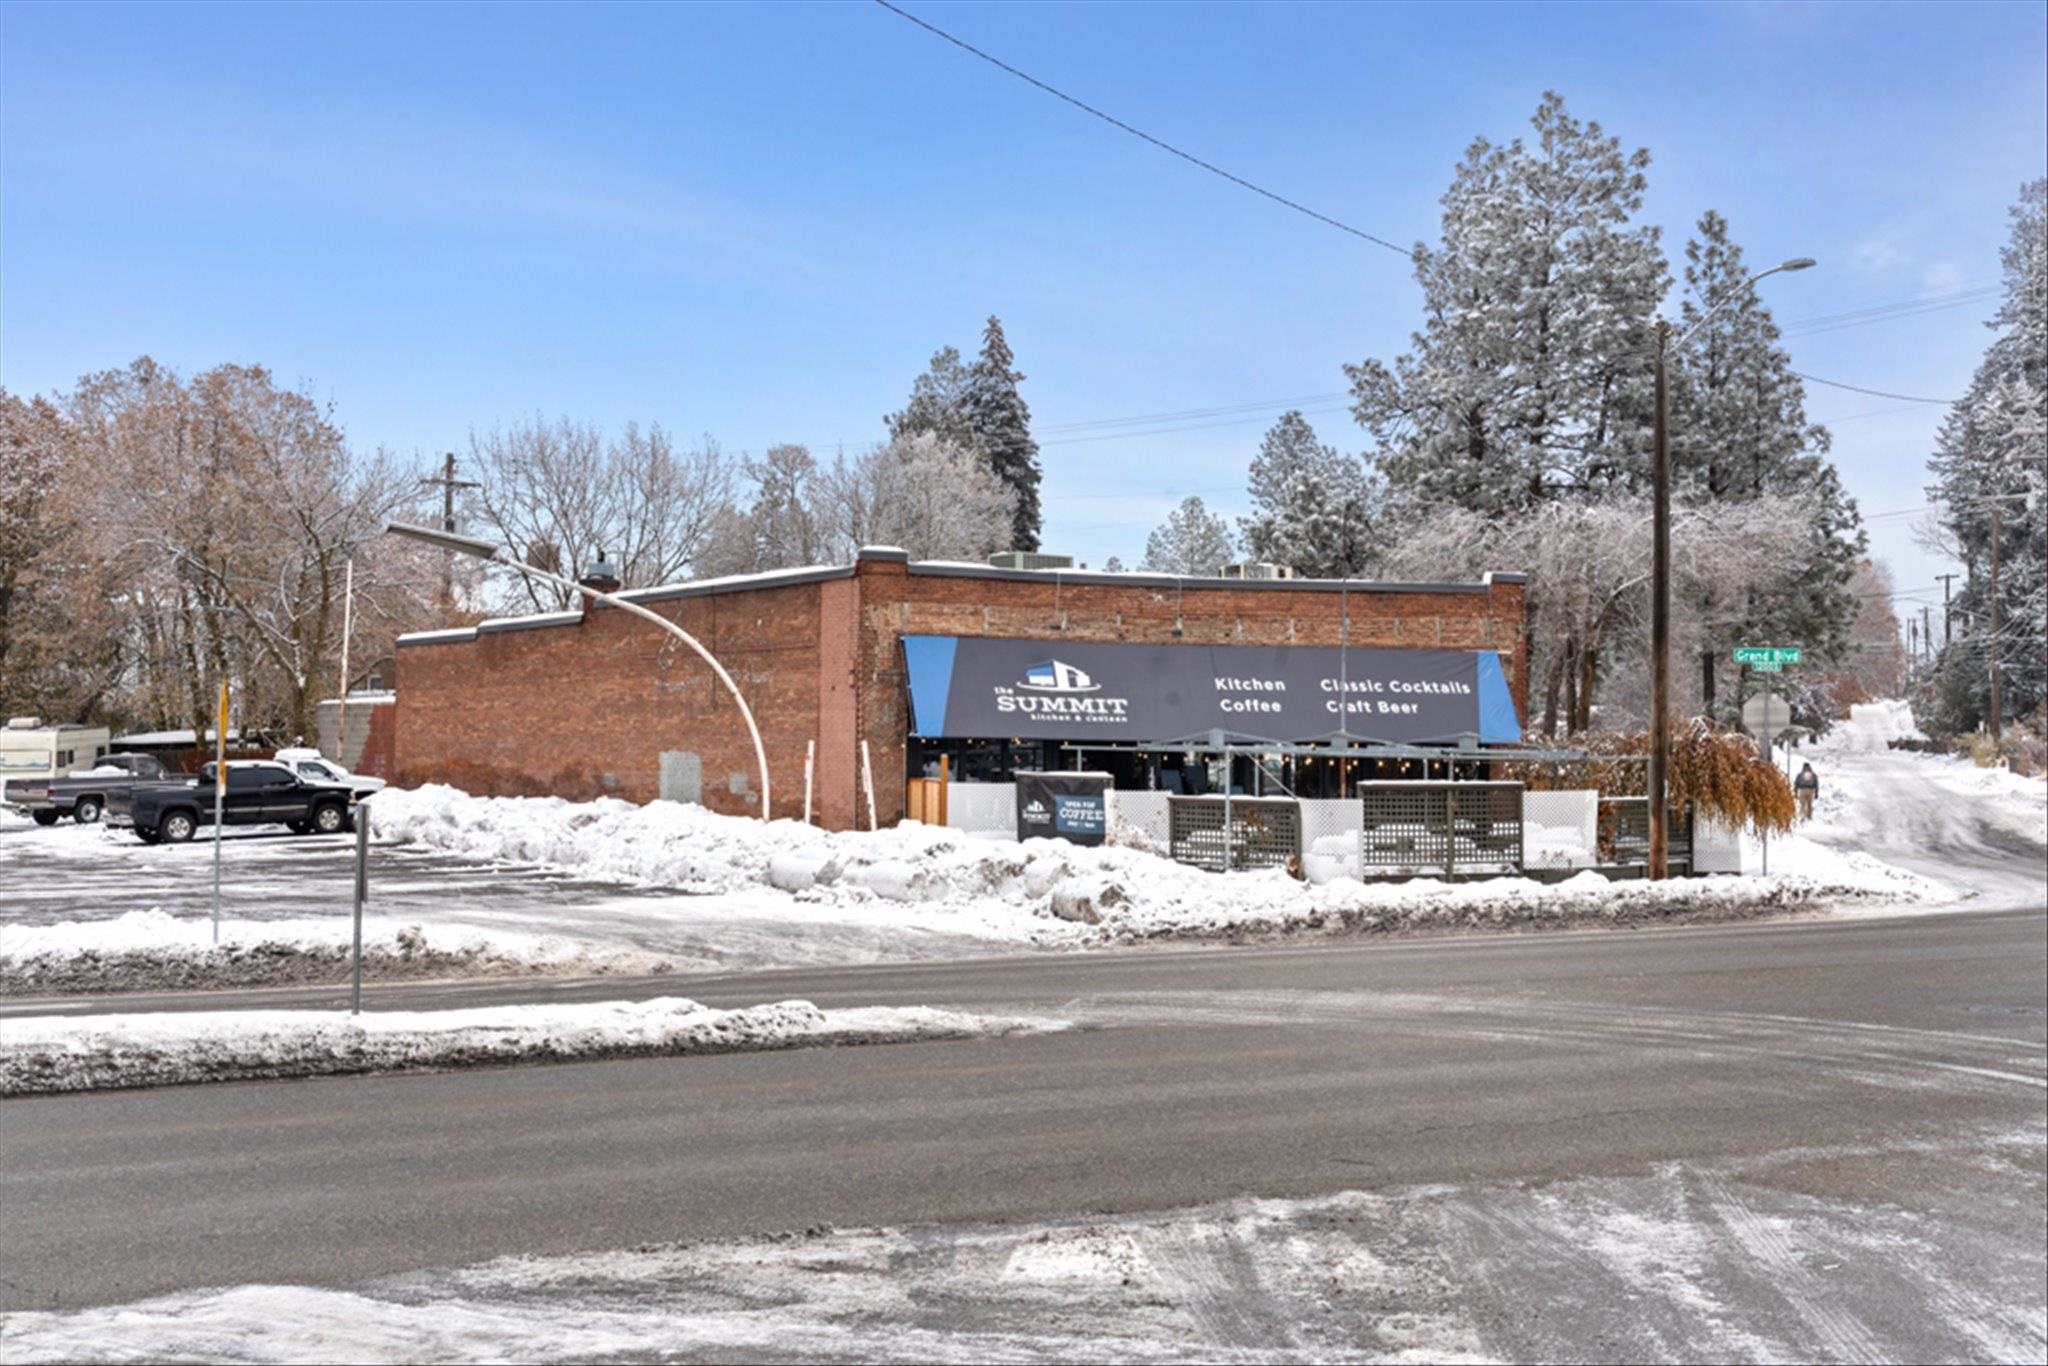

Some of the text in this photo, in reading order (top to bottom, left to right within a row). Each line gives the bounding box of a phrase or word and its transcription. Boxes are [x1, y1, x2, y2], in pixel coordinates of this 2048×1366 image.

[1737, 650, 1798, 662] Grand Blvd
[1214, 677, 1286, 691] Kitchen
[1320, 678, 1471, 694] Classic Cocktails
[996, 695, 1128, 714] SUMMIT
[1220, 699, 1282, 712] Coffee
[1378, 701, 1419, 714] Beer
[1059, 807, 1104, 820] COFFEE
